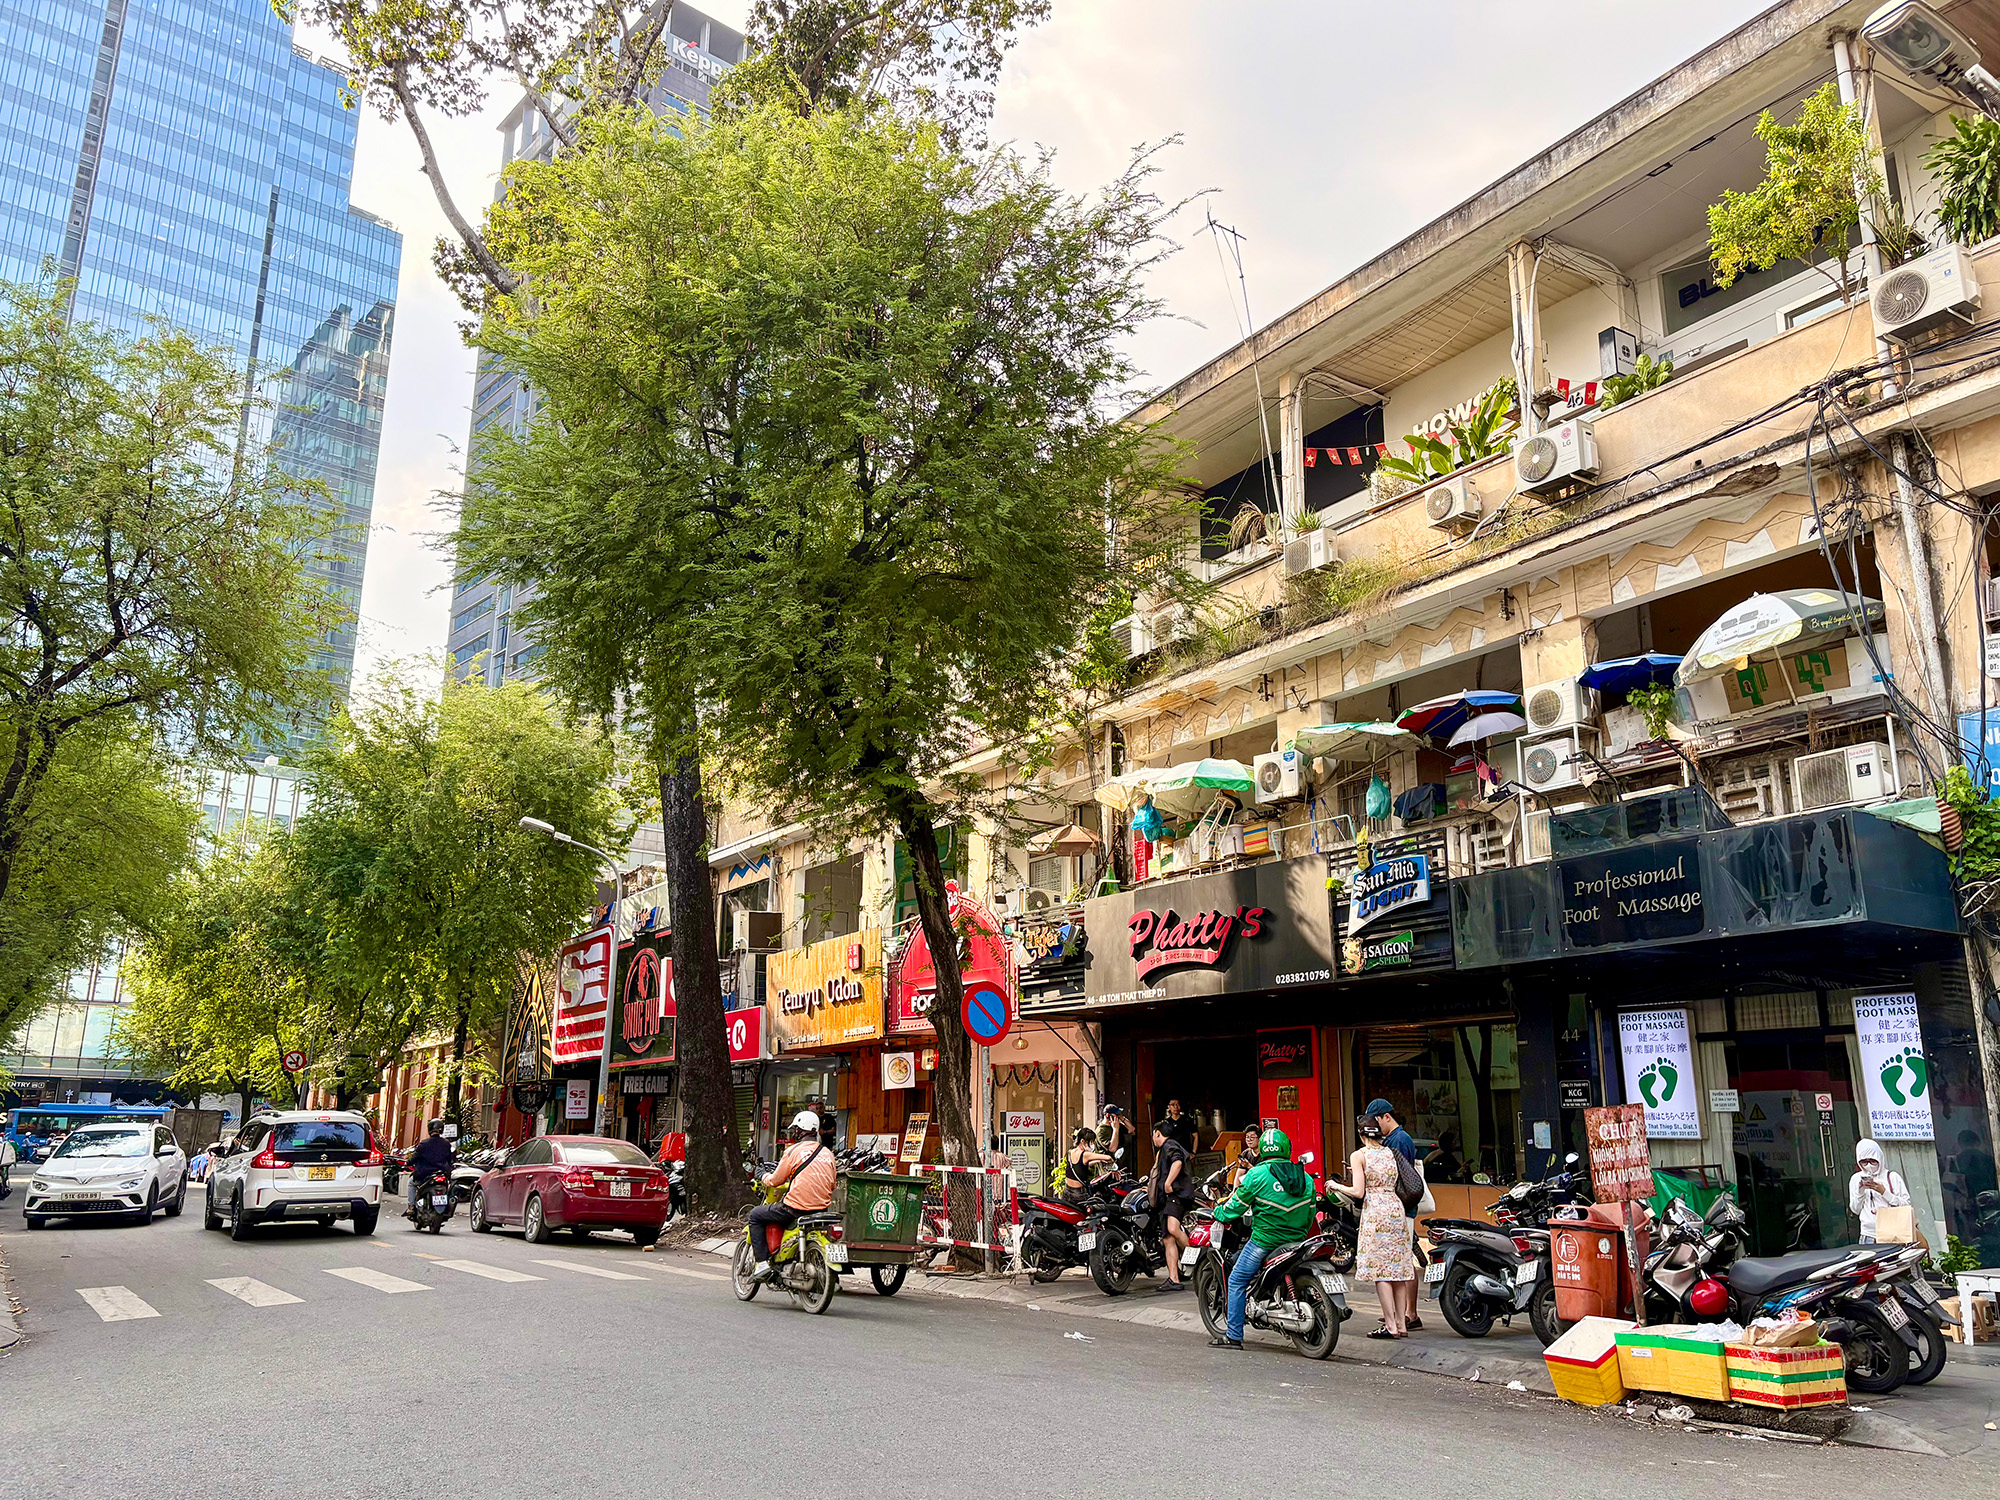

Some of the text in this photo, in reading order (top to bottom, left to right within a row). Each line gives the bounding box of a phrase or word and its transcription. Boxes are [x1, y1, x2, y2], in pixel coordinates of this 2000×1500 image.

[1567, 392, 1584, 408] 46
[1562, 439, 1571, 448] LG
[1353, 860, 1416, 900] San Mig
[1574, 856, 1686, 899] Professional
[1357, 883, 1415, 918] LIGHT
[1563, 891, 1702, 925] Foot Massage
[1025, 926, 1062, 957] Tiger
[1369, 942, 1409, 957] SAIGON
[1380, 954, 1412, 965] SPECIAL
[1275, 970, 1330, 985] 02838210796
[778, 977, 860, 1014] Tenryu Udon
[1107, 993, 1120, 1002] TON
[1120, 991, 1137, 1001] THAT
[1137, 989, 1156, 999] THIEP
[1157, 988, 1166, 997] D1
[1855, 995, 1915, 1008] PROFESSIO
[1620, 1011, 1684, 1023] PROFESSIONAL
[1857, 1008, 1884, 1018] FOOT
[1888, 1006, 1916, 1017] MASS
[623, 1001, 644, 1043] SNUG
[1621, 1020, 1685, 1032] FOOT MASSAGE
[735, 1025, 744, 1044] K
[1561, 1028, 1580, 1042] 44
[623, 1076, 668, 1093] FREE GAME
[1568, 1089, 1582, 1097] KCG
[1023, 1115, 1040, 1127] Spa
[1660, 1123, 1673, 1131] Thiep
[1908, 1123, 1924, 1131] Thiep
[1009, 1139, 1040, 1147] FOOT & BODY
[878, 1186, 893, 1195] C35
